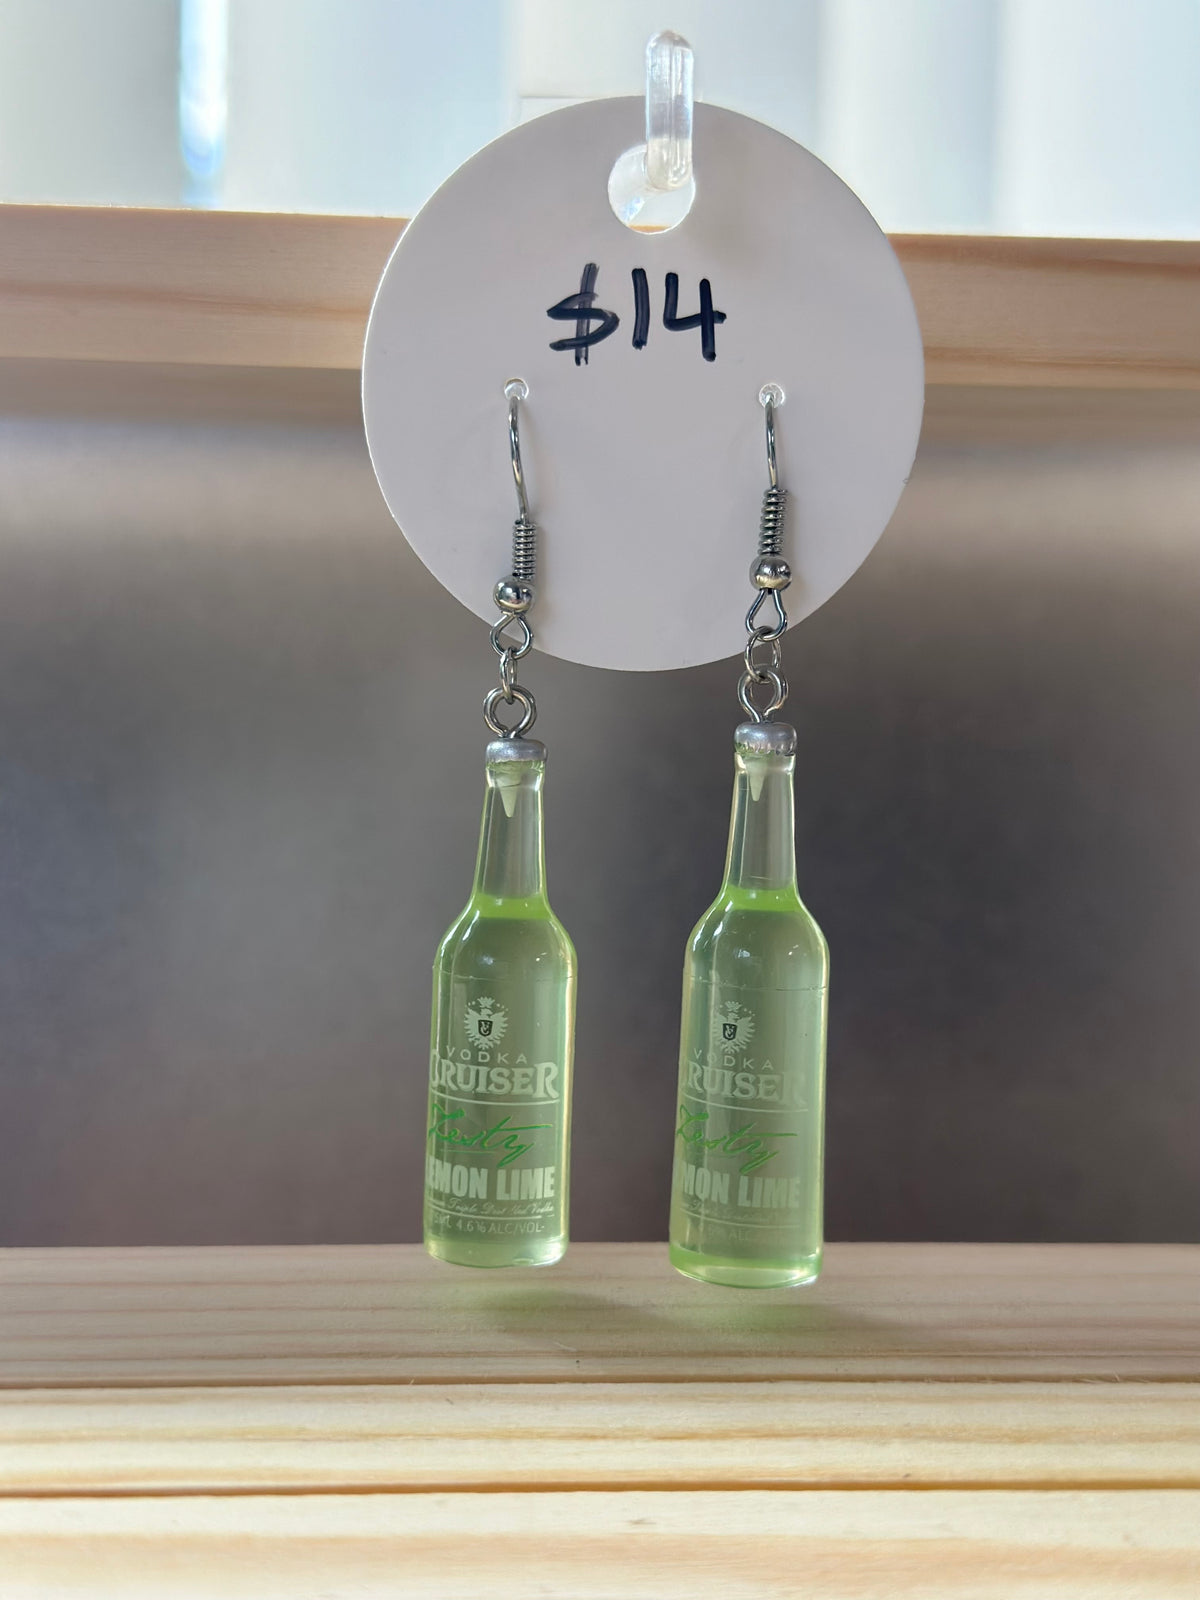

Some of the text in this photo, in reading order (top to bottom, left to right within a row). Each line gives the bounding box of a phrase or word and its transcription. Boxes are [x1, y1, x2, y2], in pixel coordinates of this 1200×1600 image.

[547, 263, 727, 366] $14
[446, 1045, 528, 1065] VODKA
[694, 1048, 774, 1070] VODKA
[687, 1060, 808, 1104] RUISER
[428, 1155, 556, 1201] EMON LIME
[738, 1175, 800, 1209] LIME
